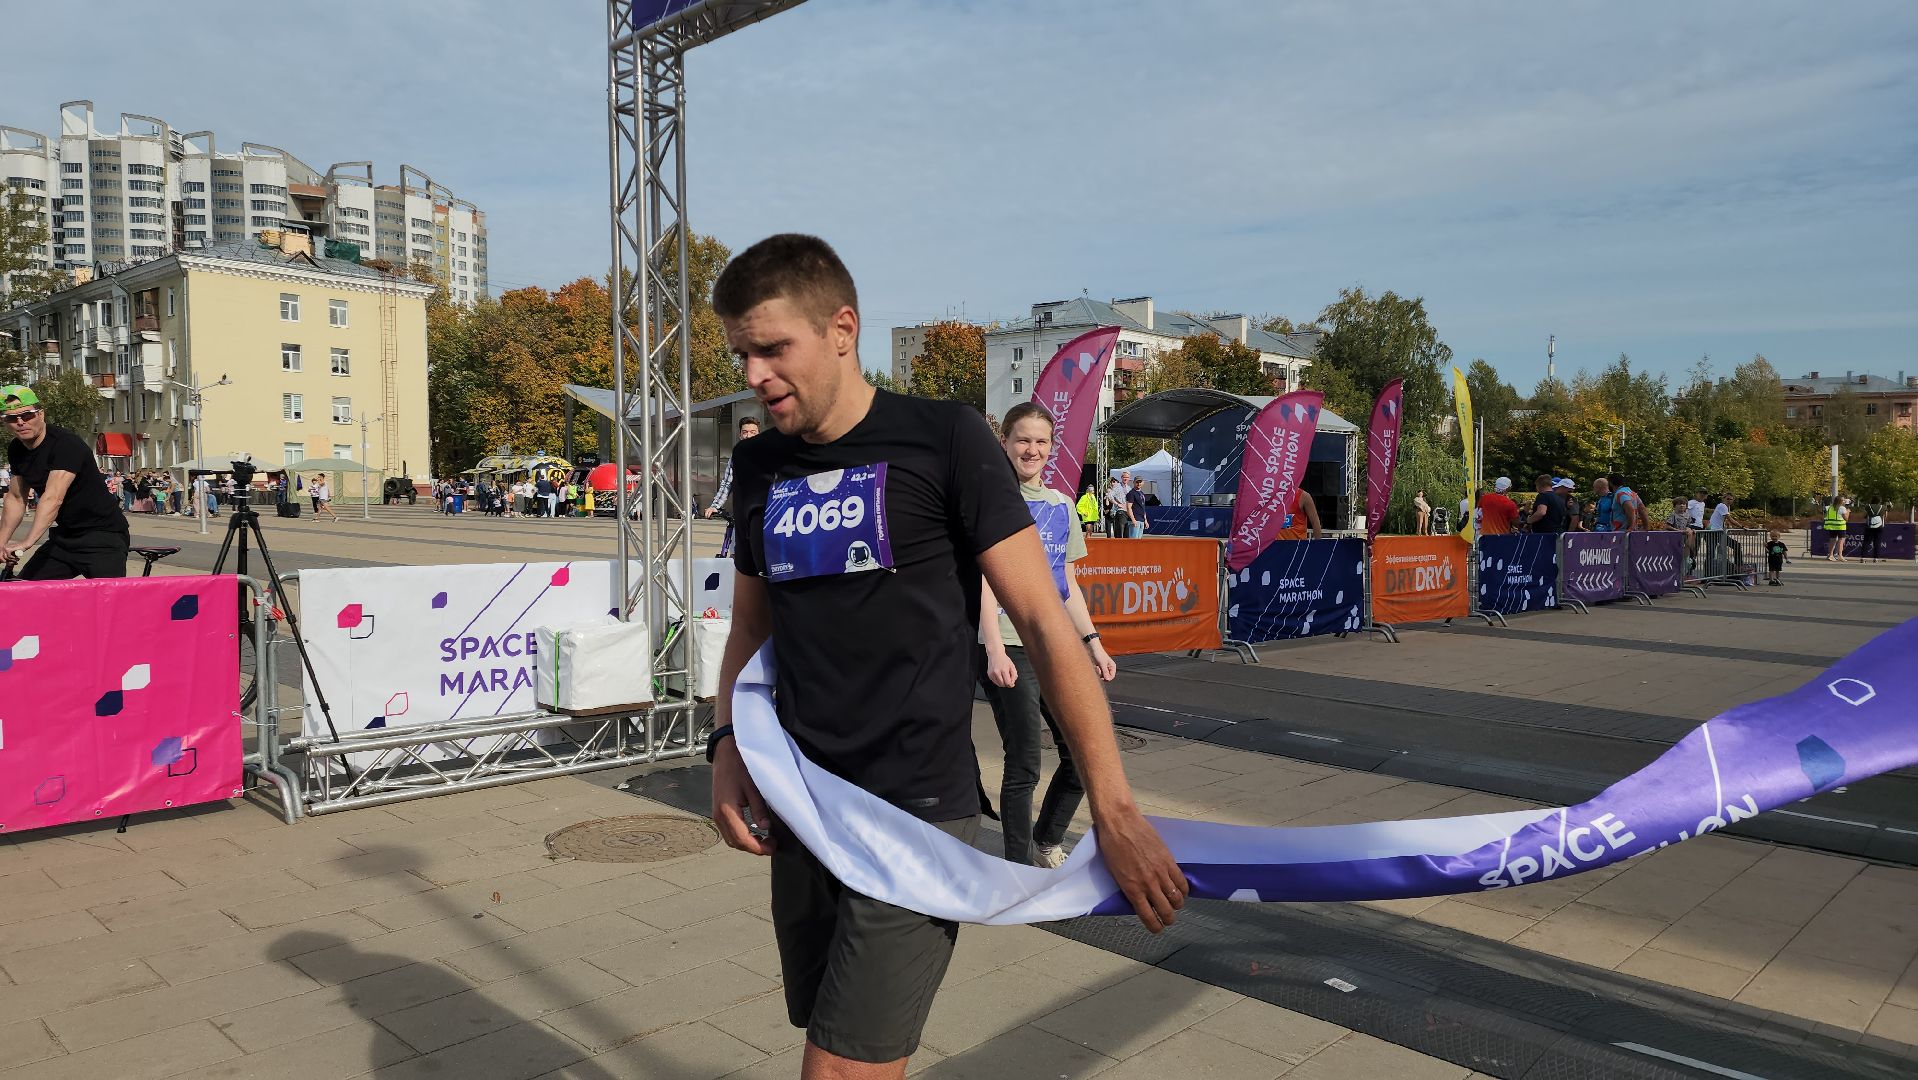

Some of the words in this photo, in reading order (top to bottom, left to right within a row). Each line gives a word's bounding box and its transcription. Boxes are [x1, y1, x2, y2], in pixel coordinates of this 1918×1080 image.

[1236, 424, 1251, 432] SPA
[1265, 426, 1286, 474] SPACE
[1242, 512, 1270, 546] HALF
[1267, 431, 1301, 513] MARATHON
[1259, 477, 1275, 508] AND
[773, 495, 865, 538] 4069
[1845, 534, 1865, 542] PACE
[1507, 564, 1523, 574] SPACE
[1579, 548, 1611, 567] ФИНИШ
[1074, 563, 1127, 578] ффективные
[1128, 564, 1162, 576] средства
[1385, 565, 1443, 593] DRYDRY
[1507, 574, 1533, 584] MARATHON
[1279, 577, 1305, 589] SPACE
[1279, 589, 1323, 603] MARATHON
[440, 632, 537, 662] SPACE
[440, 665, 537, 697] MARA
[1479, 812, 1637, 891] SPACE
